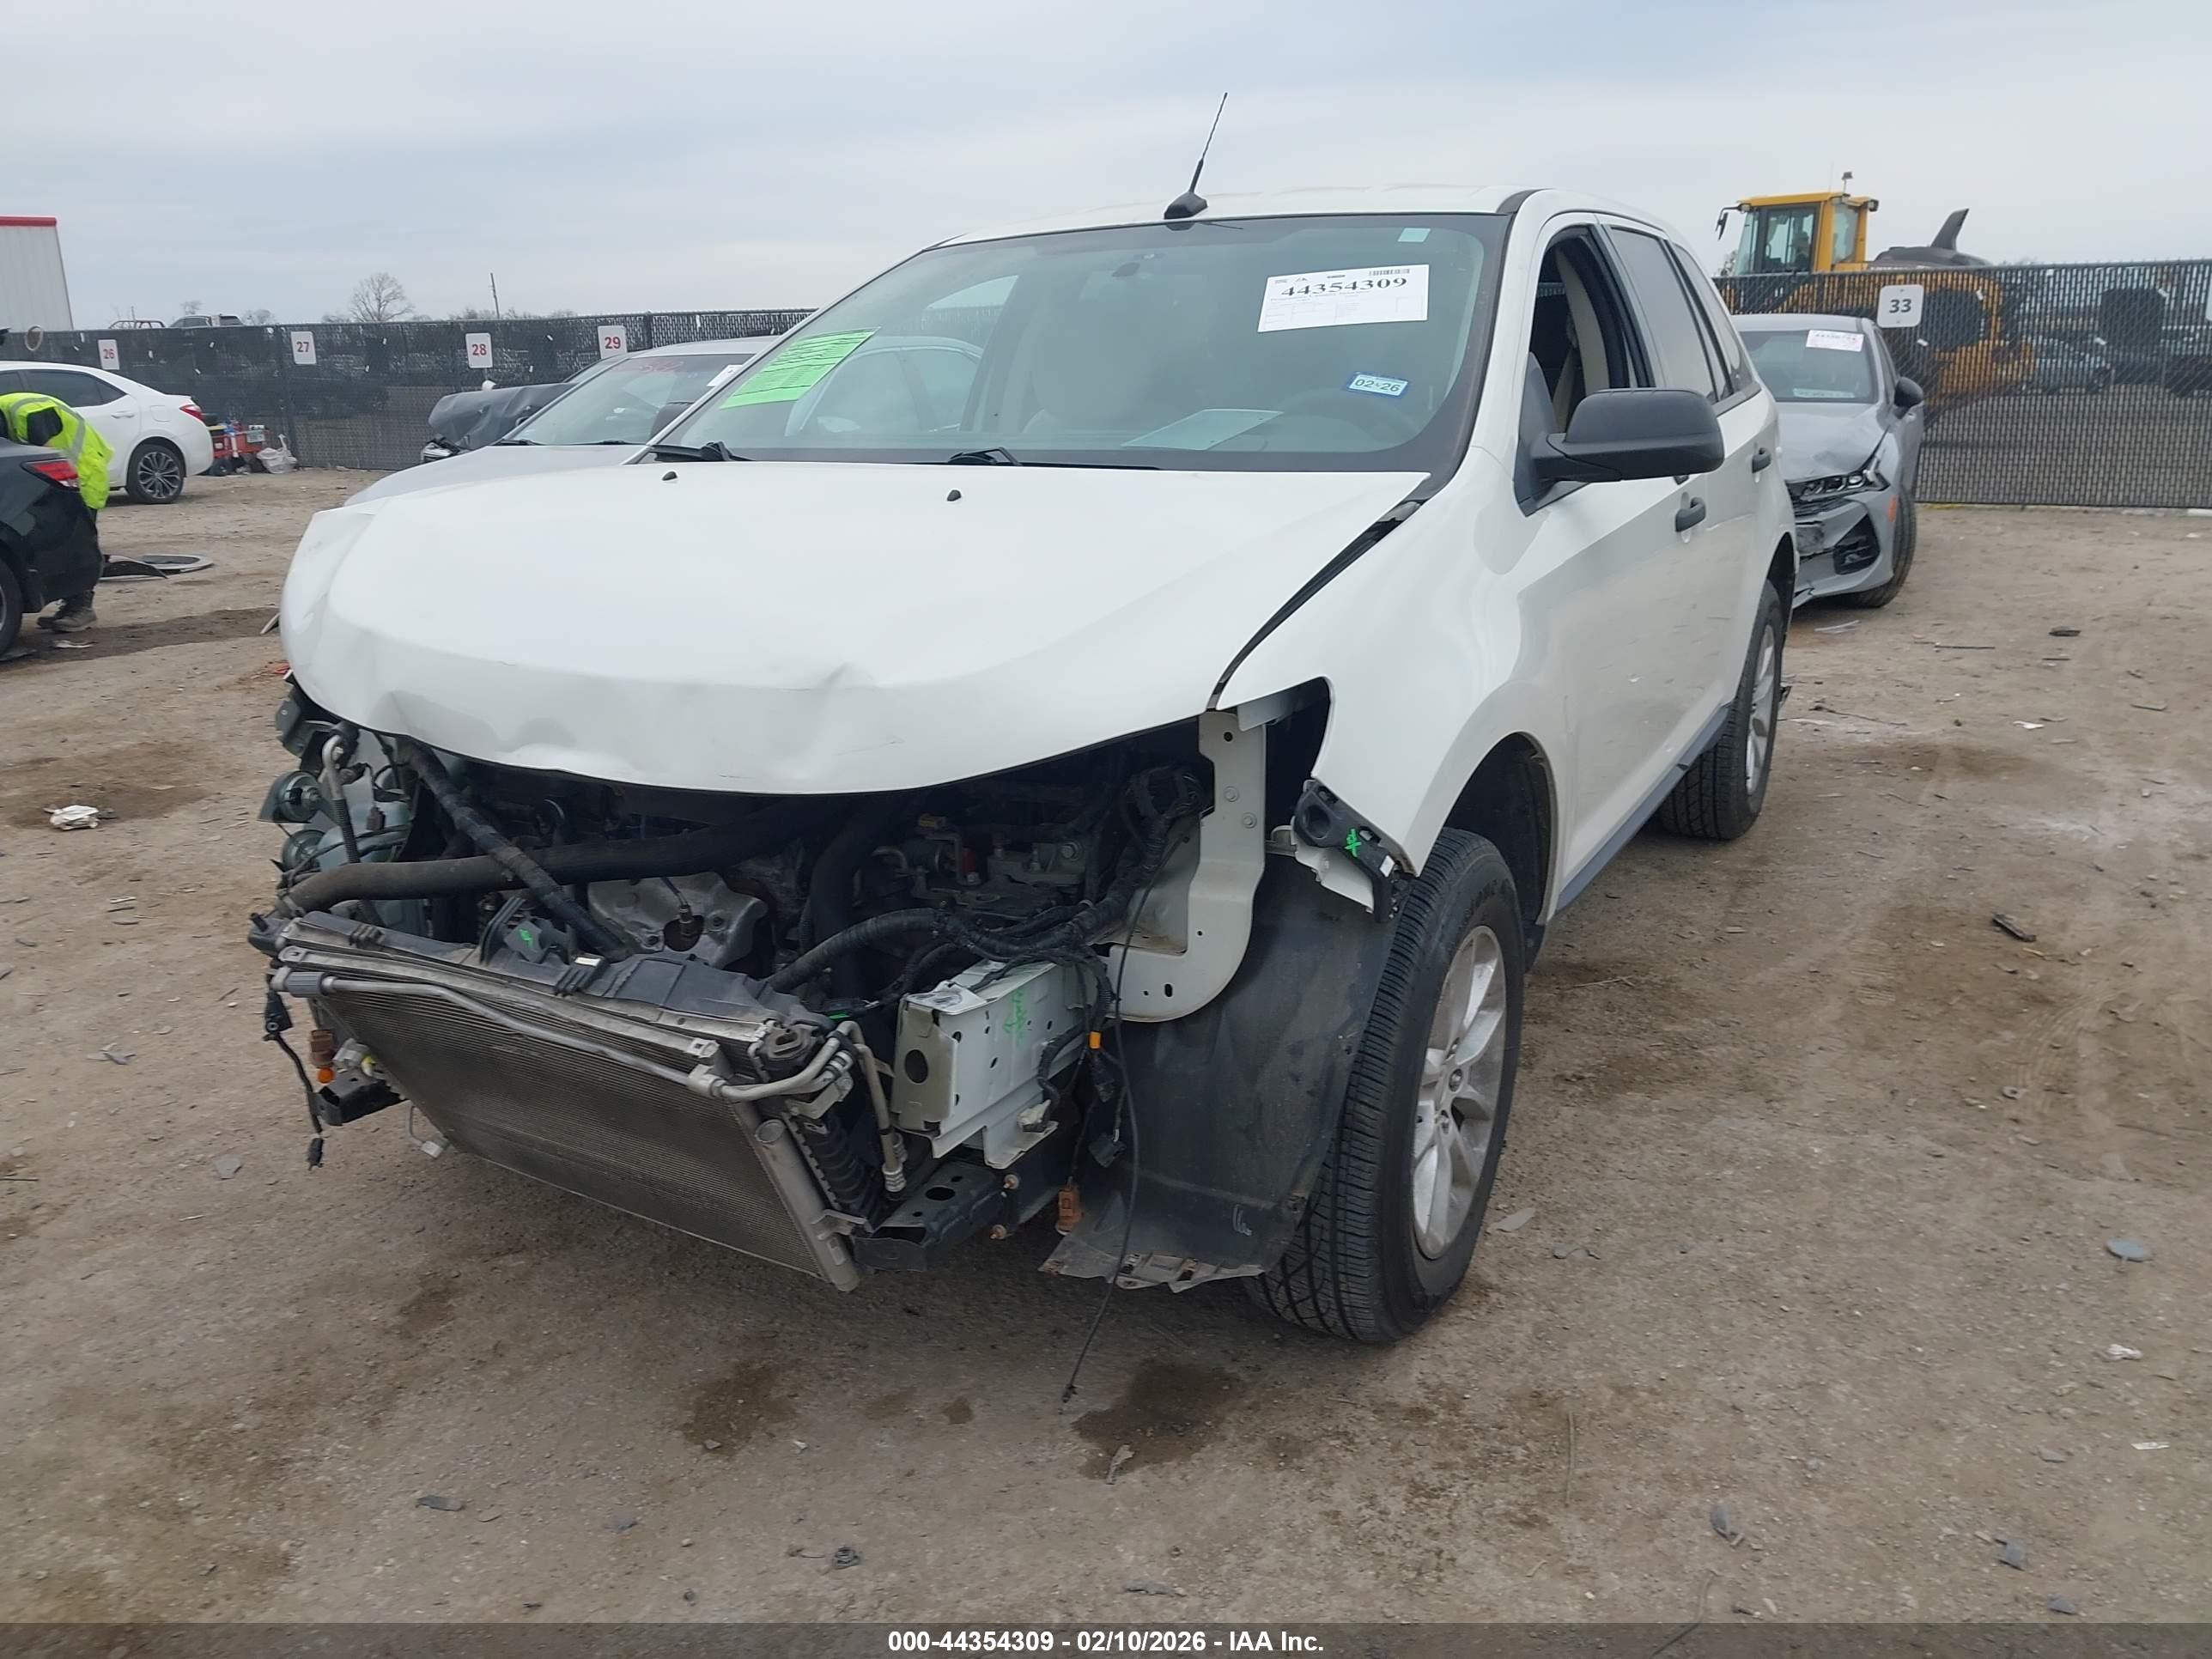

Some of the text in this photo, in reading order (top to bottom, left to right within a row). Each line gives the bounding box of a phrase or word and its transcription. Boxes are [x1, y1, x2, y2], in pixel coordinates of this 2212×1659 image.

[1280, 277, 1407, 296] 44354309
[1889, 298, 1911, 313] 33
[297, 341, 310, 353] 27
[605, 336, 621, 349] 29
[103, 349, 115, 359] 26
[472, 344, 487, 356] 28
